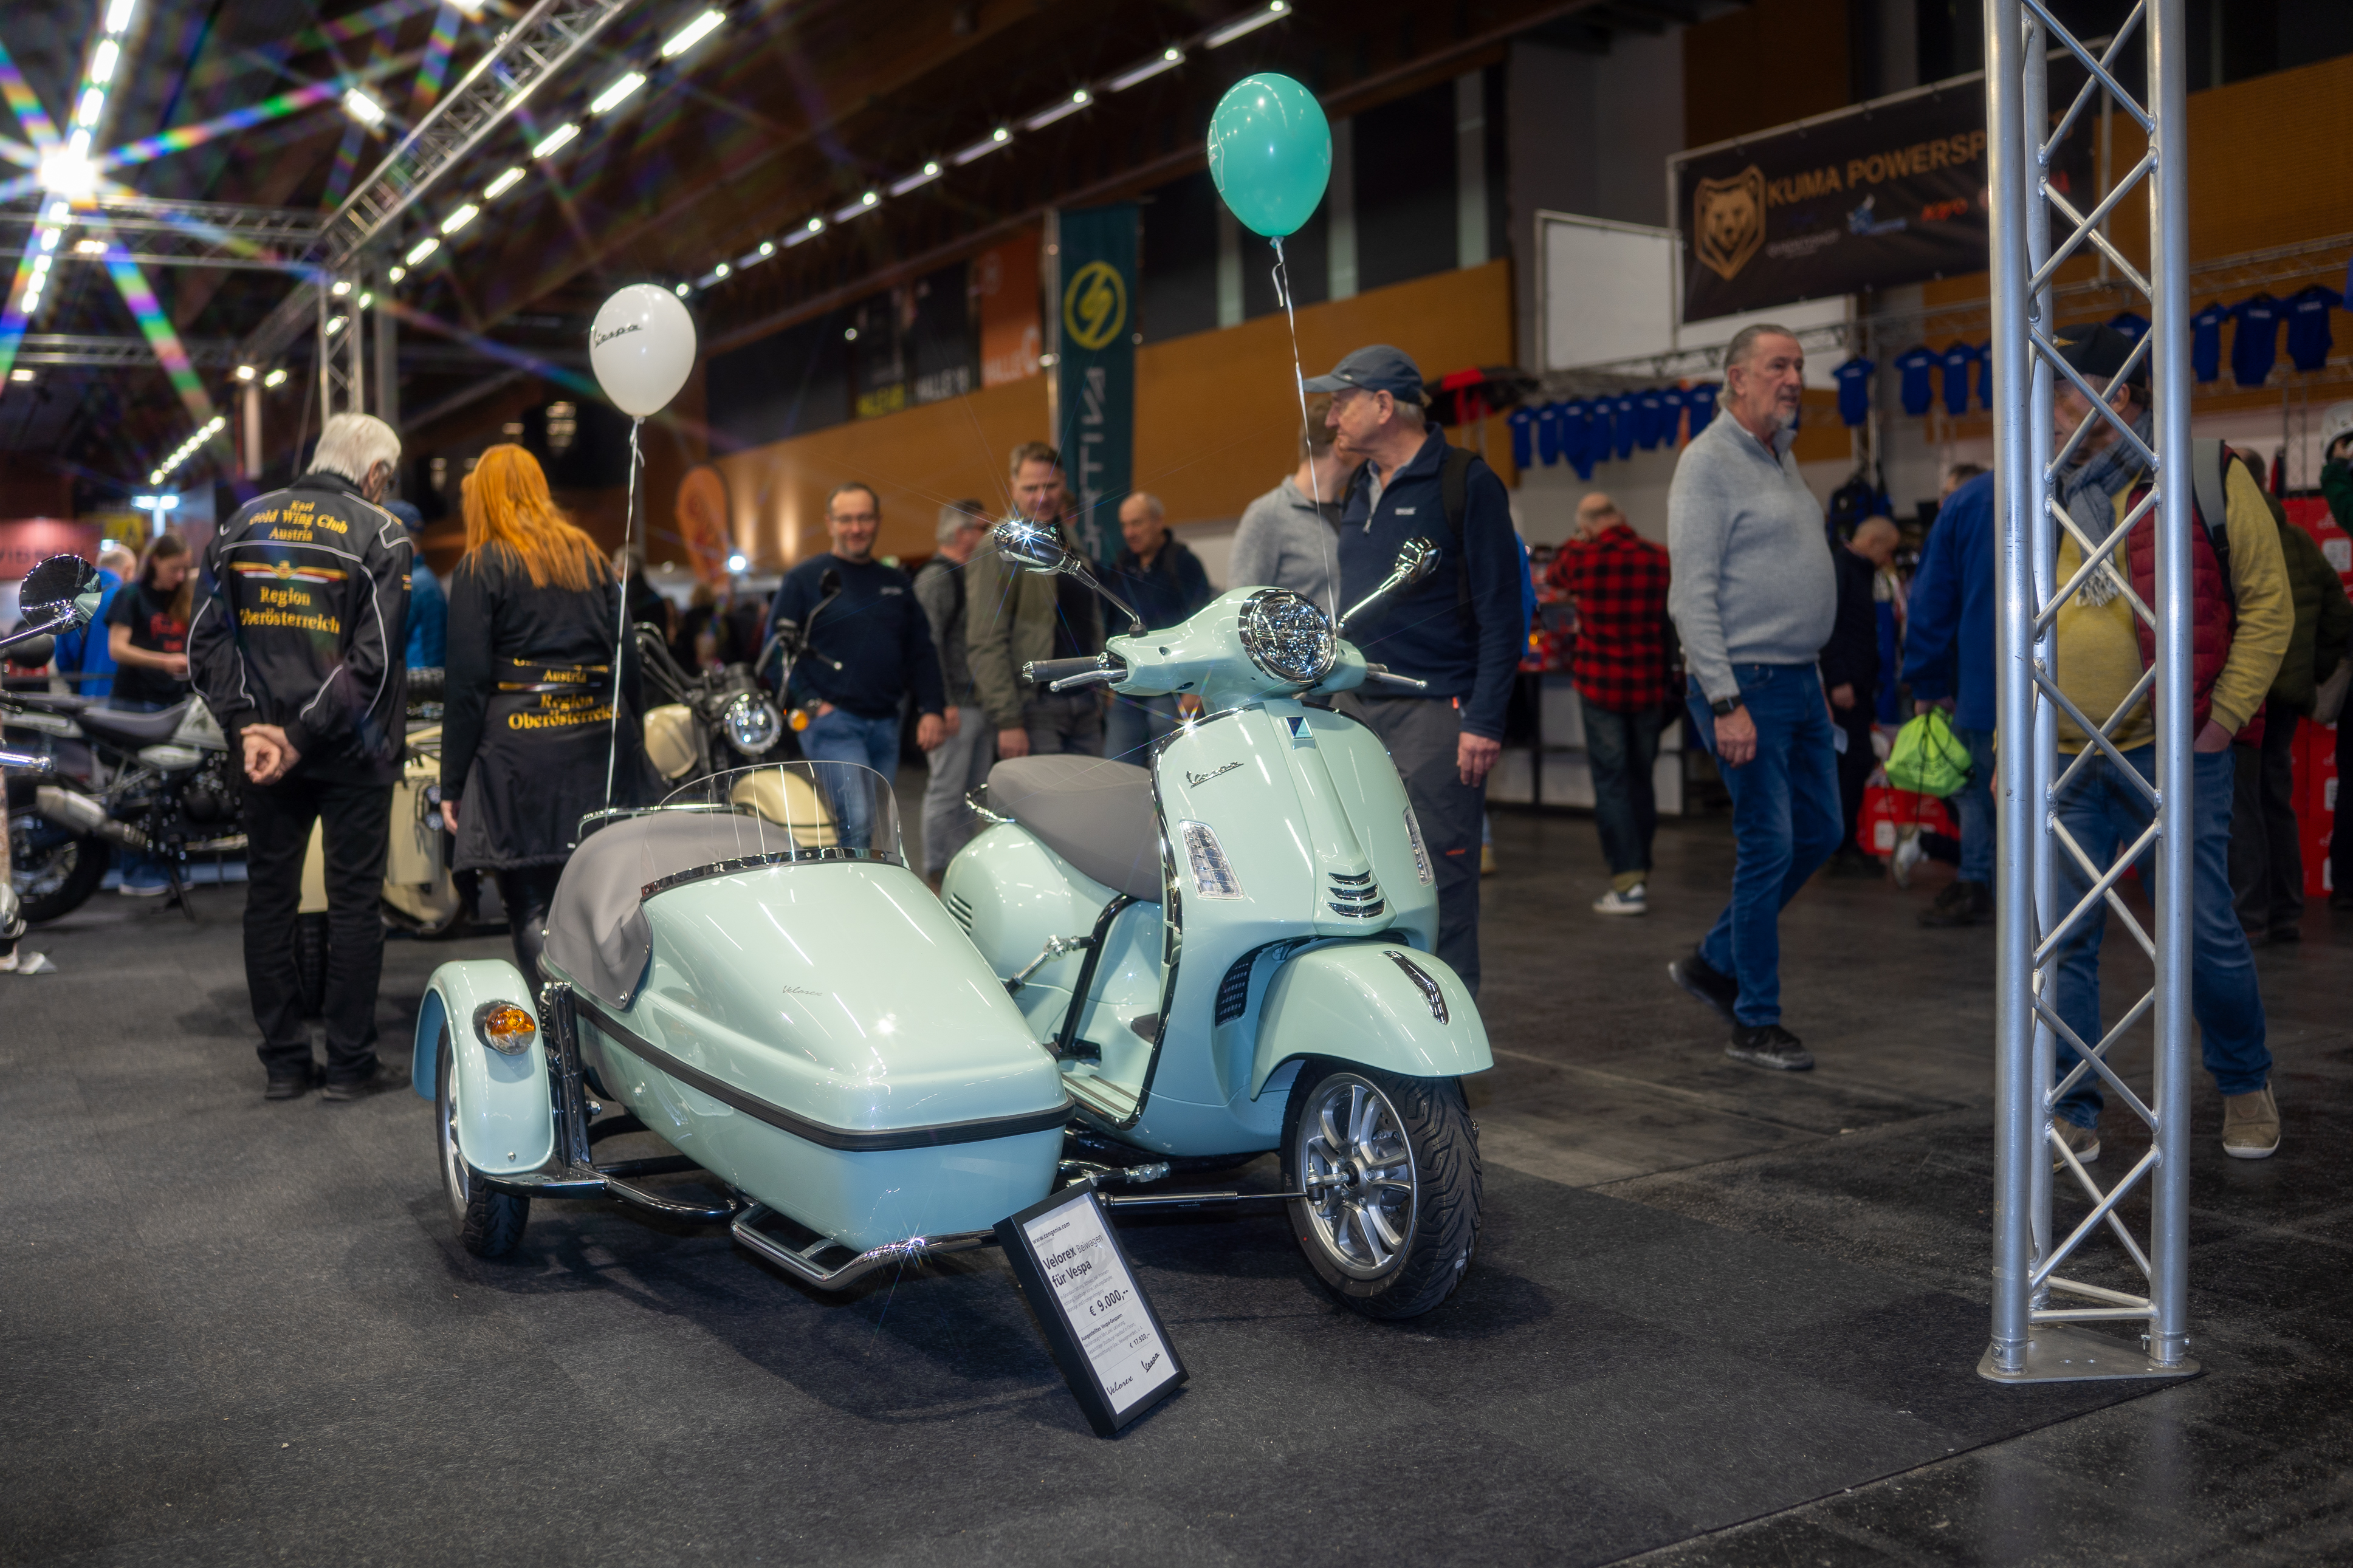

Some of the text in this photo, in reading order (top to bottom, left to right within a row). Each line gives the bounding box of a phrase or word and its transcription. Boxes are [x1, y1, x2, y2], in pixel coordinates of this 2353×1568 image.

[1767, 130, 1987, 208] KUMA POWERSP
[593, 324, 643, 349] Vespa
[268, 526, 313, 542] Austria
[283, 509, 314, 528] Wing
[317, 514, 348, 534] Club
[260, 586, 311, 607] Region
[543, 669, 587, 683] Austria
[1186, 761, 1244, 789] Vespa
[782, 985, 823, 996] Velorex
[1032, 1222, 1071, 1244] www.congenia.com
[1042, 1247, 1077, 1270] Velorex
[1076, 1234, 1104, 1253] Beiwagen
[1051, 1261, 1093, 1288] für Vespa
[1089, 1289, 1128, 1316] € 9.000,--
[1081, 1313, 1123, 1341] Ausgestelltes Vespa-Gespann
[1106, 1352, 1161, 1396] Velorex Vespa
